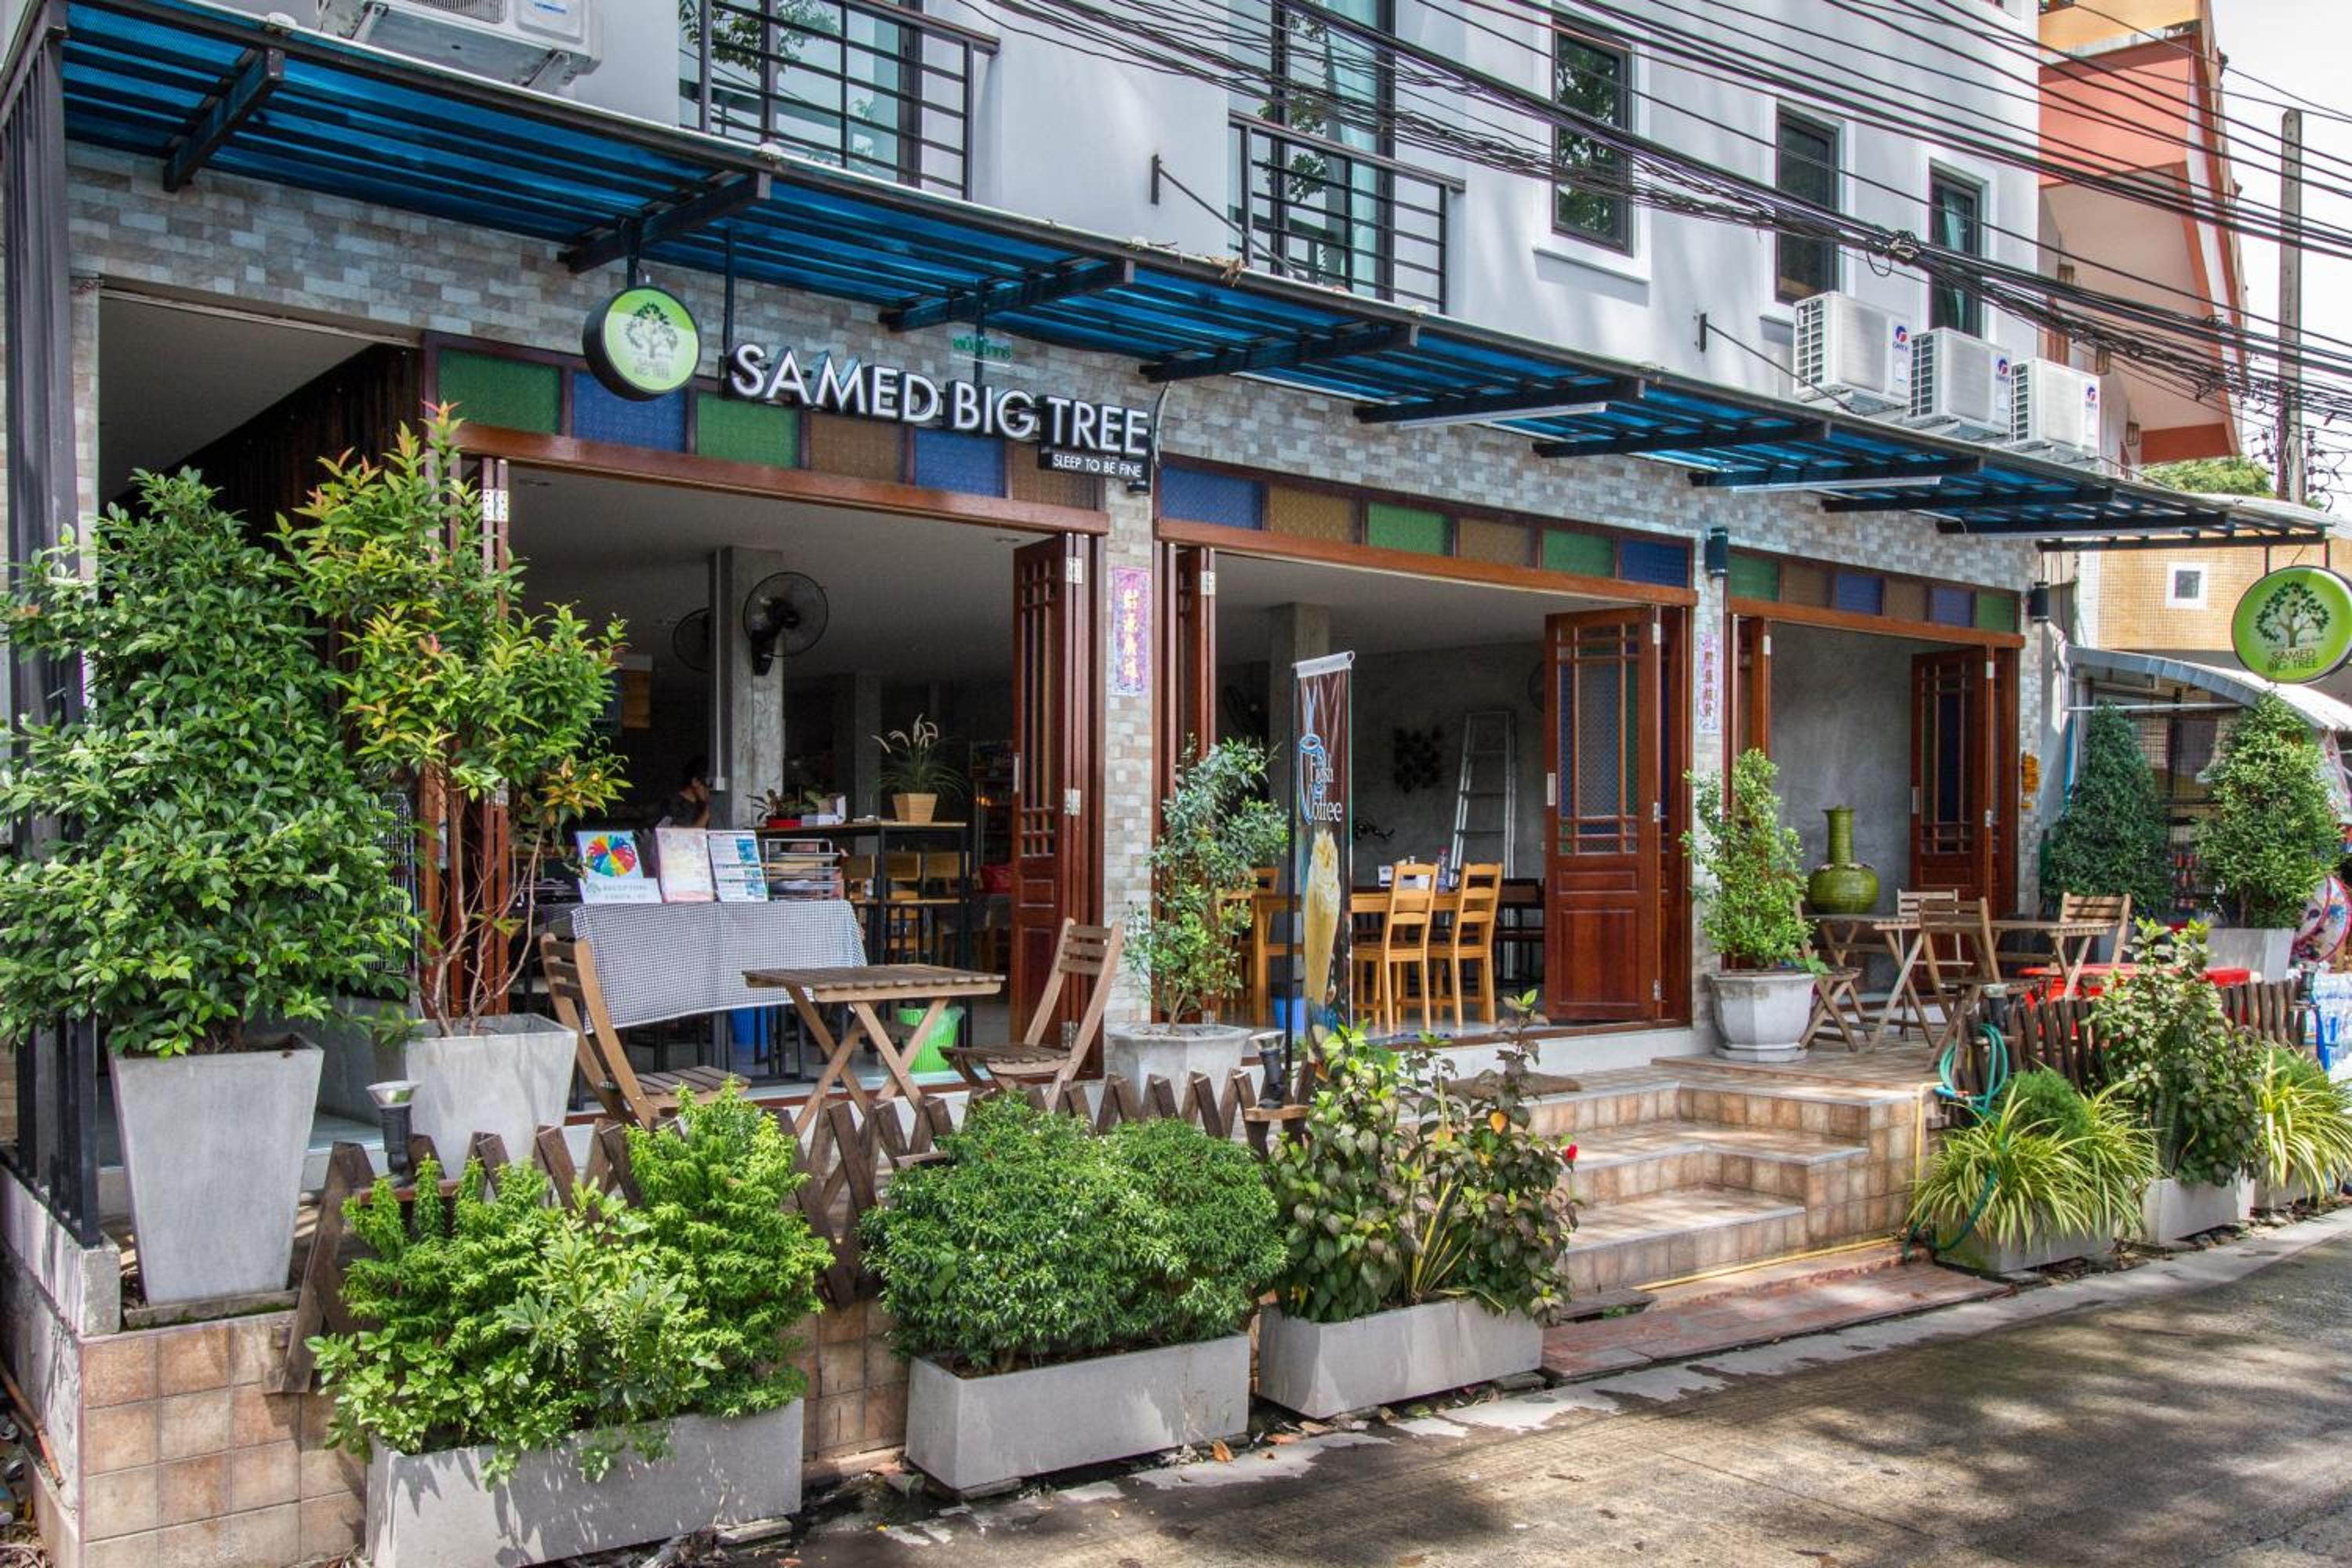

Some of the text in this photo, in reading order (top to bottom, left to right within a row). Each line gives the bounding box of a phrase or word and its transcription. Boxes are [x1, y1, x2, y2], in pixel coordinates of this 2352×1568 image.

[731, 343, 938, 422] SAMED
[953, 381, 1036, 439] BIG
[1045, 395, 1149, 456] TREE
[1053, 454, 1142, 477] SLEEP TO BE FINE
[2270, 648, 2316, 659] SAMED
[2294, 657, 2319, 669] TREE
